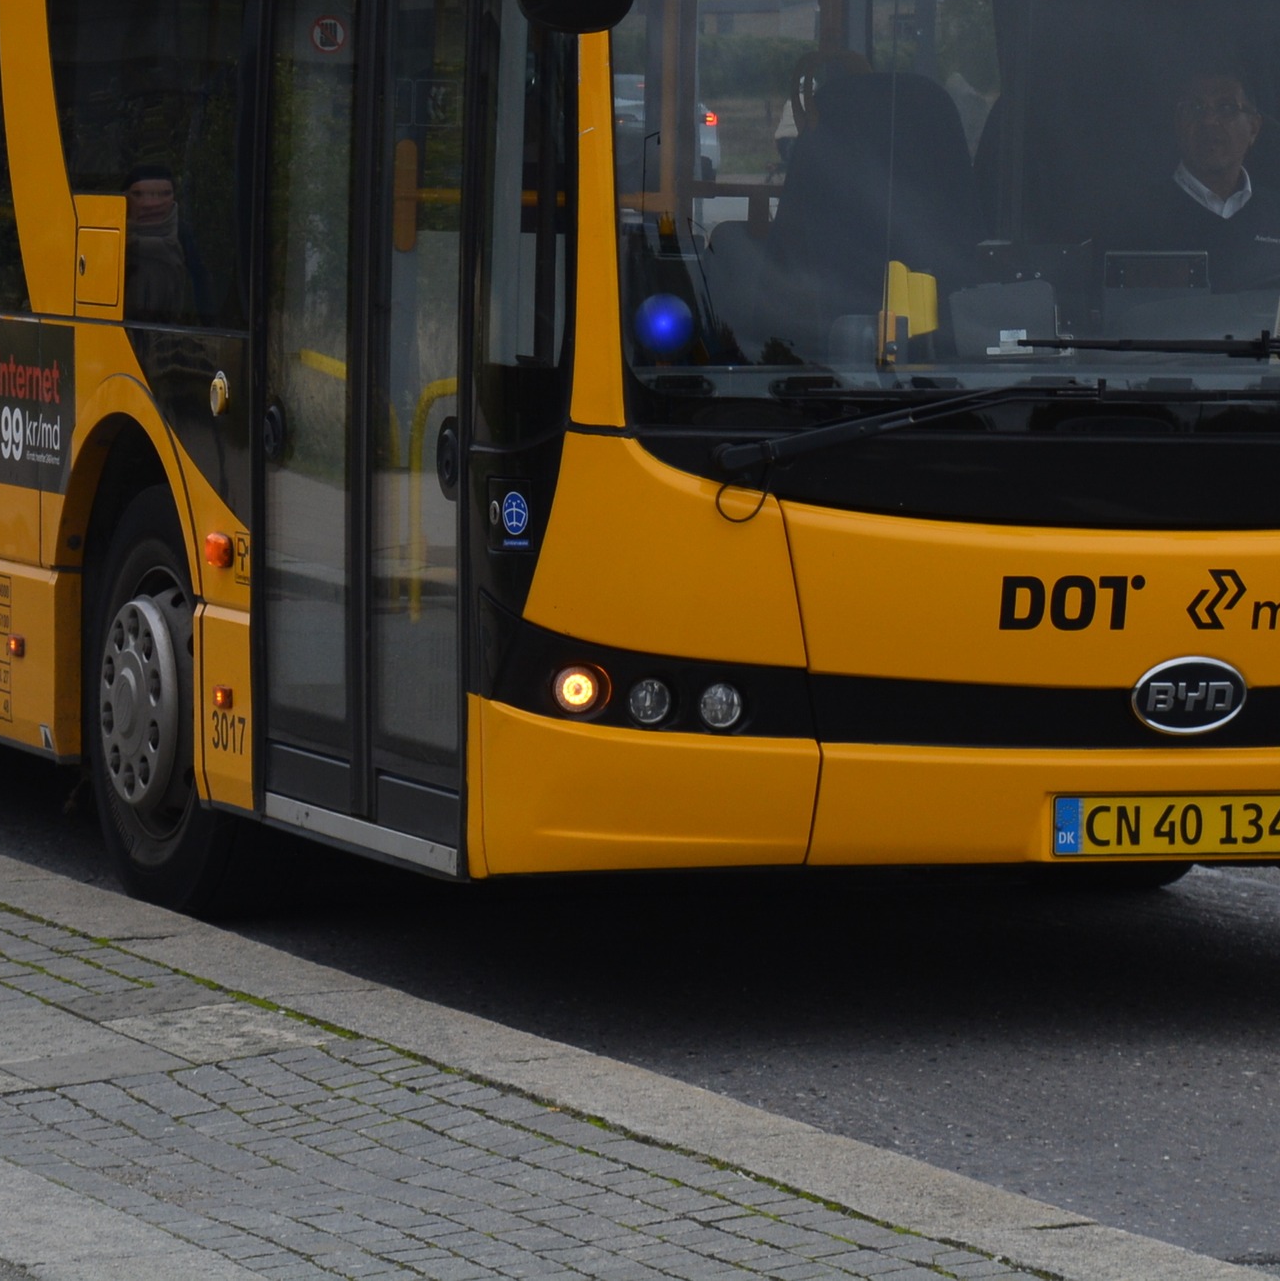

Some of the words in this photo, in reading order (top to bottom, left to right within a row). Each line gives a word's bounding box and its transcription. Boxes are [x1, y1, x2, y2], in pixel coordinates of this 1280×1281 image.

[1, 405, 24, 462] 99
[25, 410, 61, 451] kr/md
[998, 573, 1146, 632] DOT
[1146, 680, 1236, 713] BYD
[211, 710, 247, 756] 3017
[1058, 831, 1077, 845] DK
[1084, 805, 1142, 847] CN
[1153, 803, 1204, 846] 40
